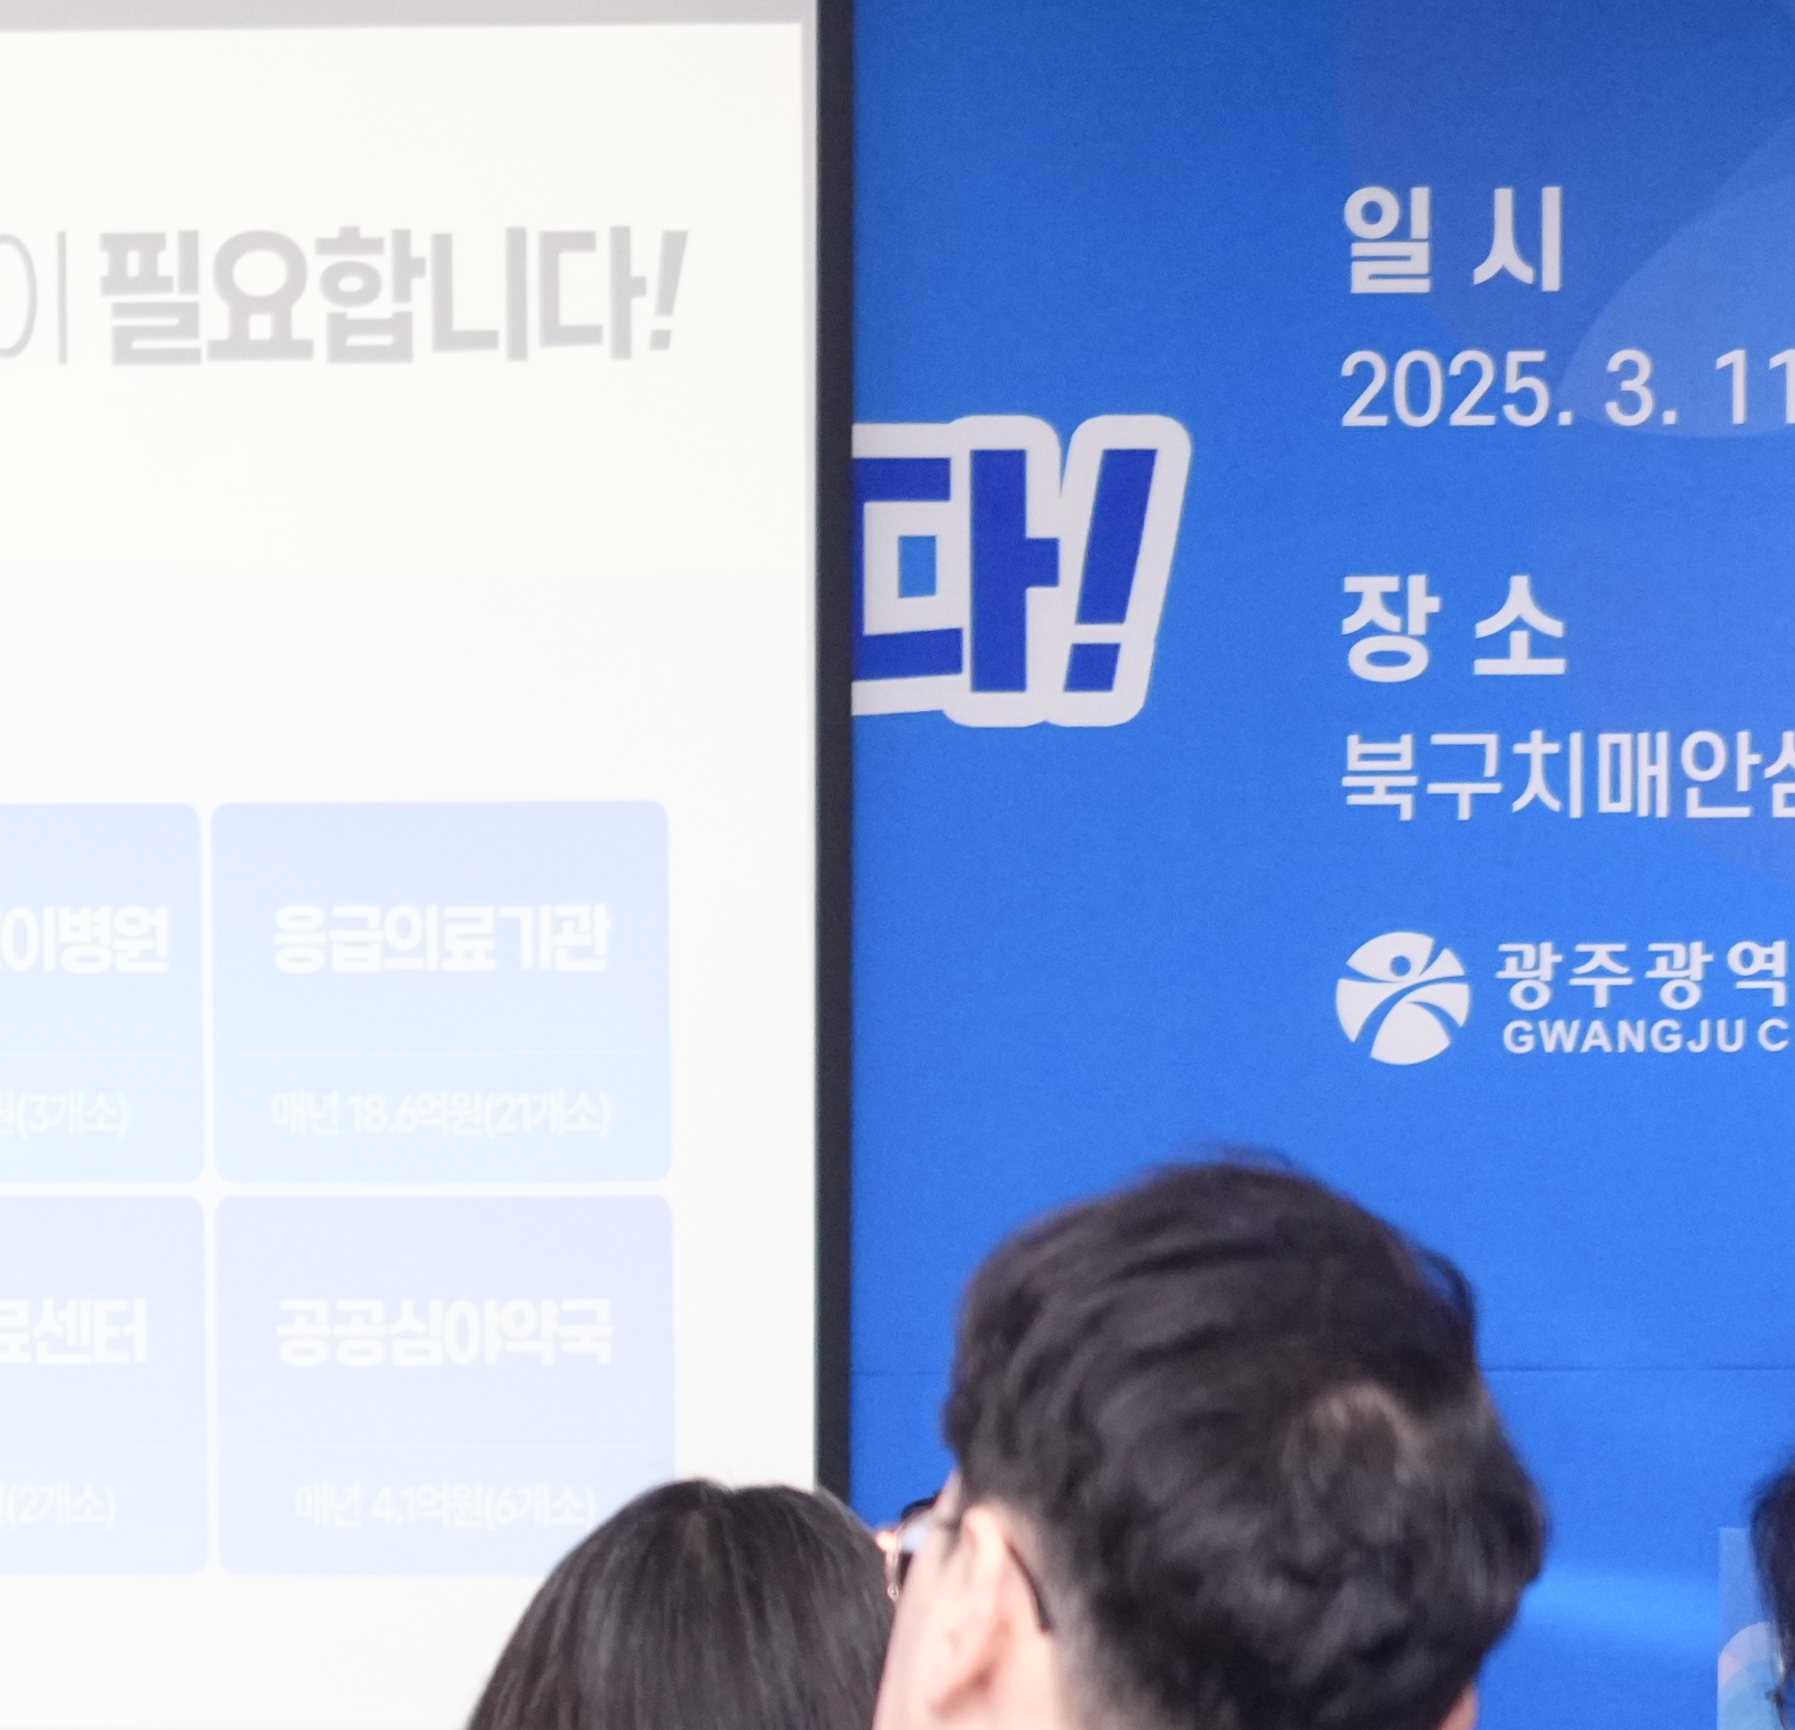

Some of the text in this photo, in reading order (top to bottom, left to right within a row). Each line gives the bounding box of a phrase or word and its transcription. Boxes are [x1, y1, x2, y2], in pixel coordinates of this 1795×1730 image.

[99, 225, 689, 366] 필요합니다!
[1341, 348, 1795, 428] 2025. 3. 11
[272, 903, 613, 975] 응급의료기관
[1496, 940, 1787, 1011] 광주광역
[1503, 1018, 1745, 1054] GWANGJU
[270, 1088, 611, 1138] 매년 18.6억원(21개소)
[276, 1298, 614, 1368] 공공심야약국
[294, 1481, 363, 1530] 매년
